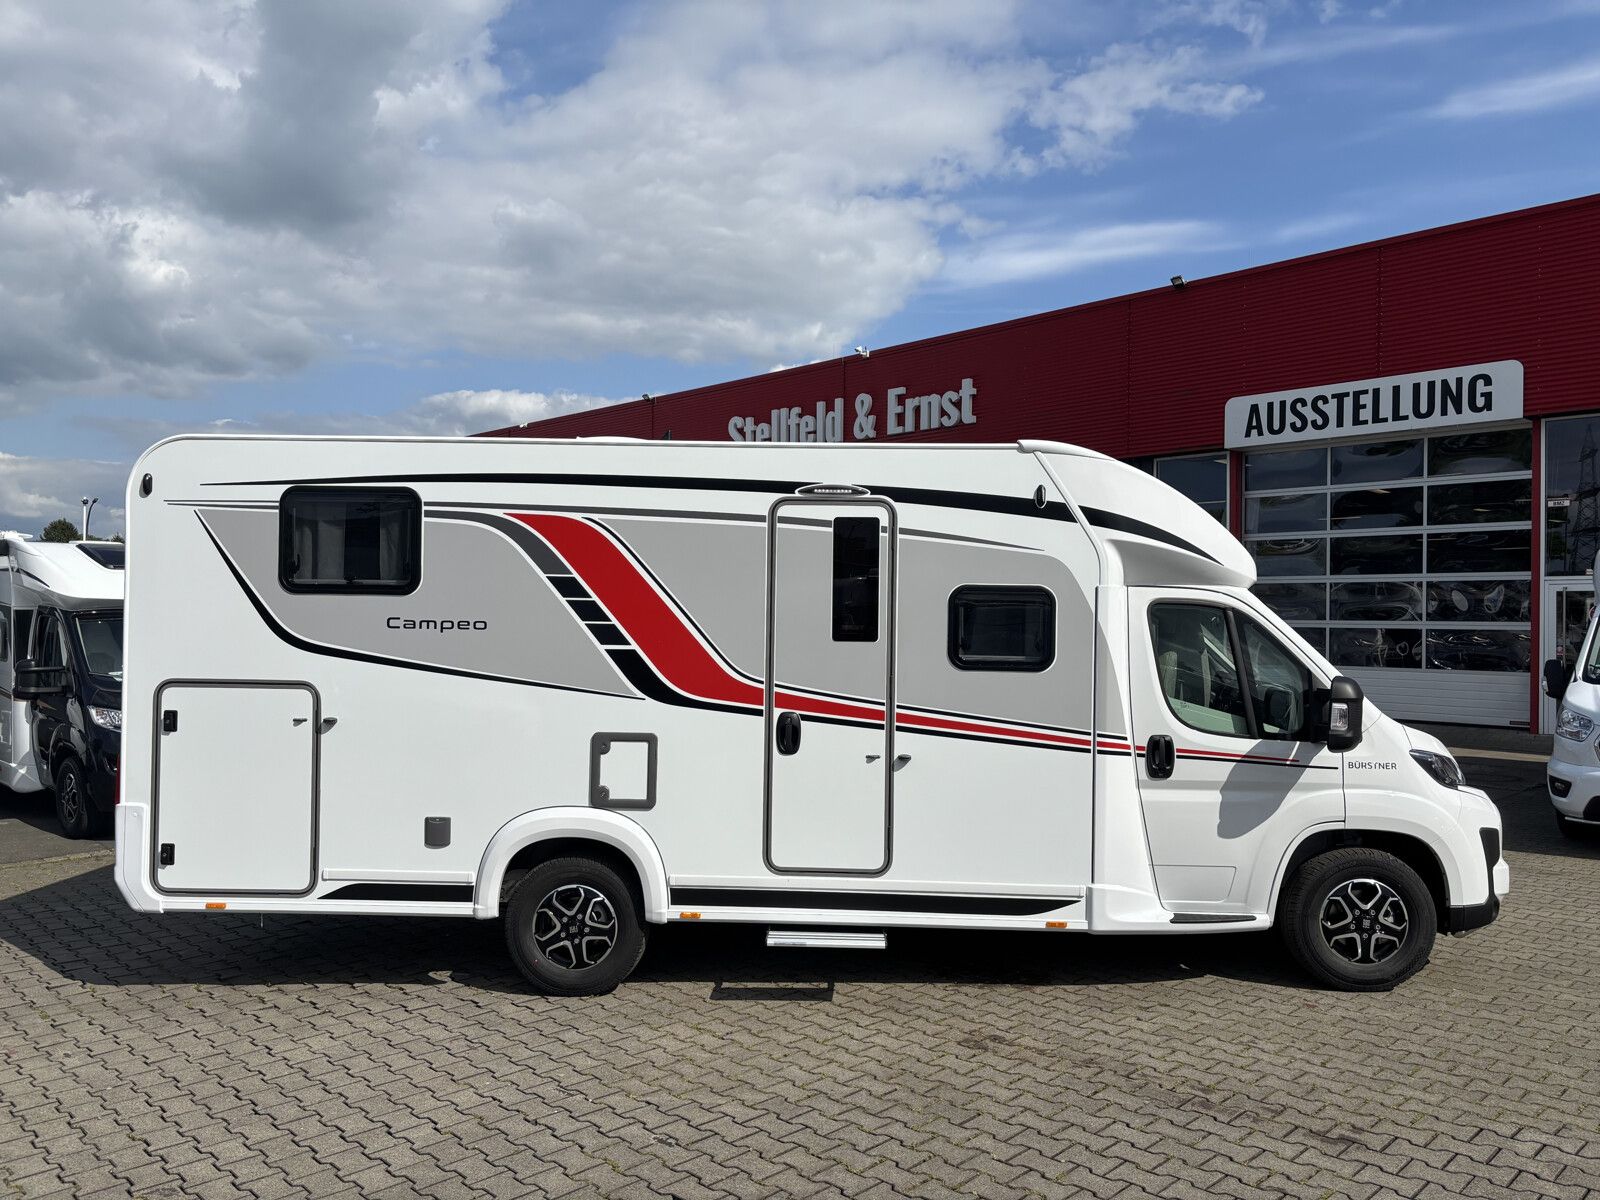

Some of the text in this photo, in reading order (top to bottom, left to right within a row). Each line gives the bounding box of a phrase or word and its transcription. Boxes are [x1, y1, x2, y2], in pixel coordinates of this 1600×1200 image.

[728, 378, 977, 442] Stellfeld & Ernst
[1244, 373, 1493, 438] AUSSTELLUNG
[386, 616, 488, 633] Campeo
[1347, 760, 1397, 770] BÜRSTNER
